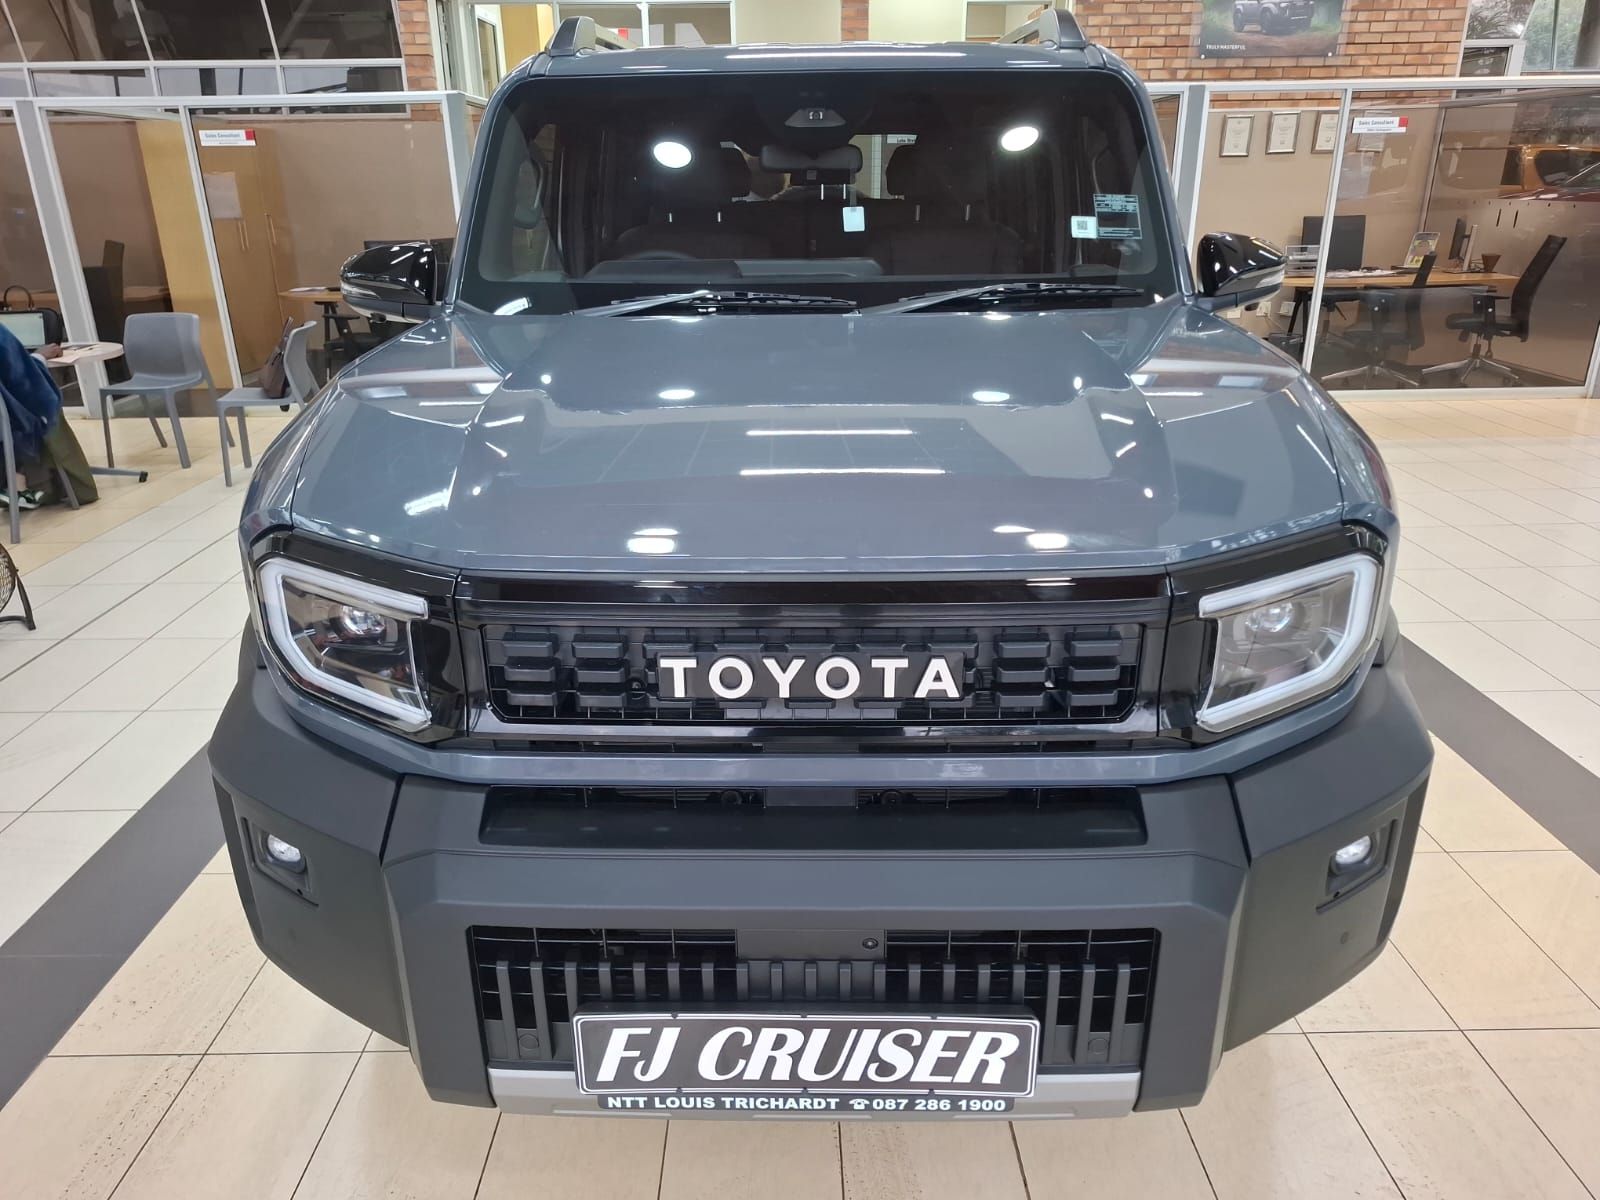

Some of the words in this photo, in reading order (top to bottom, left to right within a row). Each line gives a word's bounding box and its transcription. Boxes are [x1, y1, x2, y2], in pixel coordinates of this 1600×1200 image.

[659, 657, 960, 699] TOYOTA
[595, 1027, 682, 1082] FJ
[697, 1026, 1020, 1084] CRUISER
[607, 1096, 649, 1109] NTT
[654, 1096, 716, 1110] LOUIS
[720, 1096, 840, 1111] TRICHARDT
[872, 1098, 909, 1111] 087
[914, 1098, 951, 1112] 286
[957, 1098, 1007, 1112] 1900
